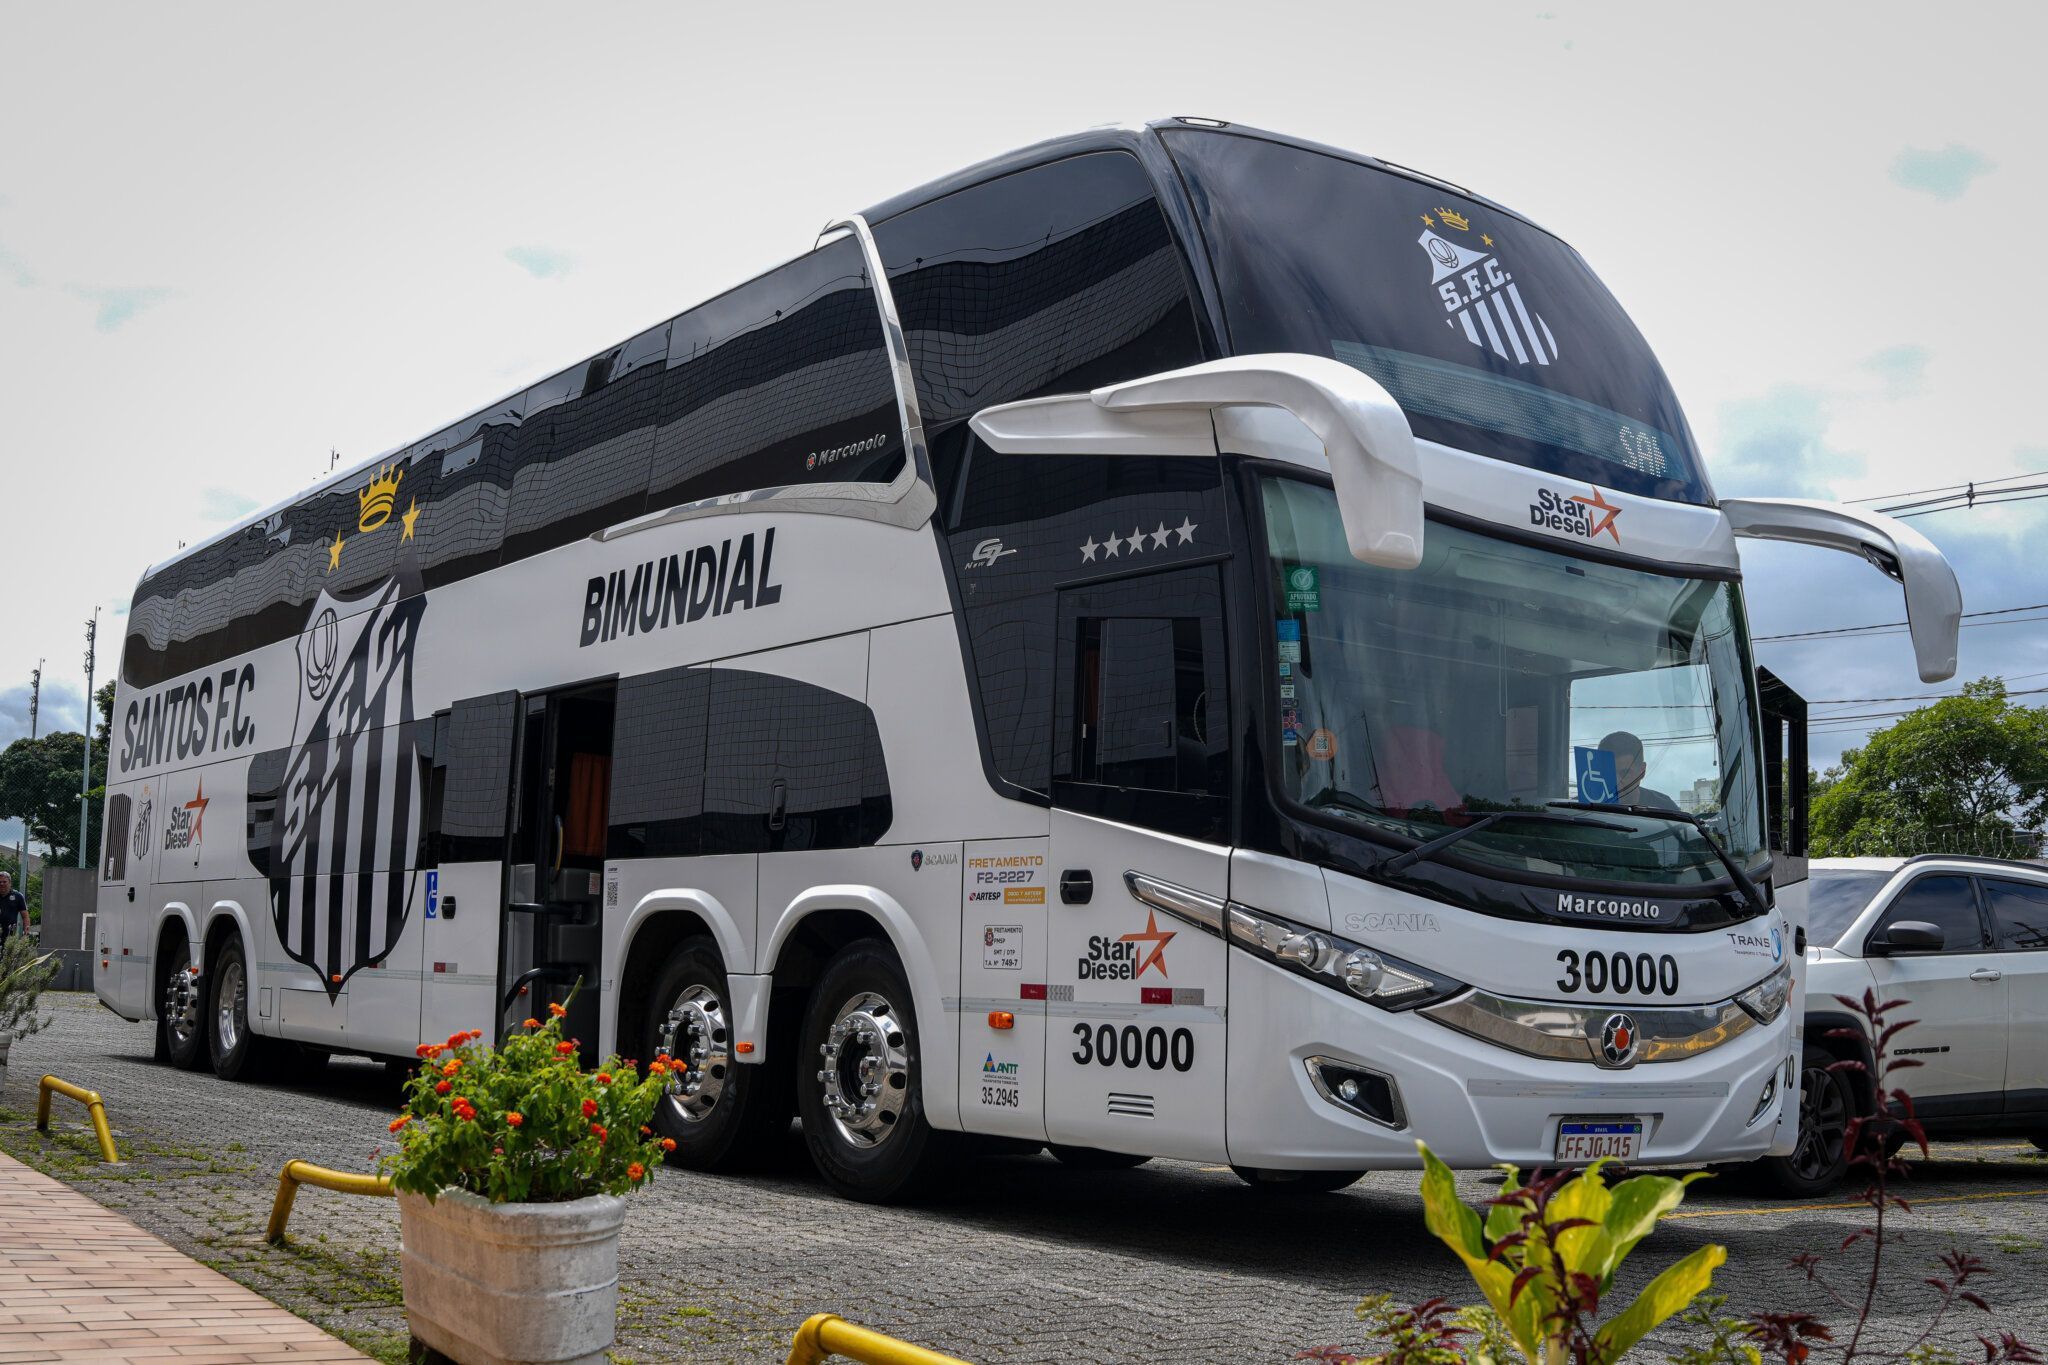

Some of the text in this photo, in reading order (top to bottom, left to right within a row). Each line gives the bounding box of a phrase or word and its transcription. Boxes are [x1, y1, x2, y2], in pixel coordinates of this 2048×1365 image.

[1438, 257, 1512, 313] S.F.C.
[818, 433, 886, 466] Marcopolo
[1538, 488, 1586, 519] Star
[1529, 504, 1591, 538] Diesel
[579, 527, 782, 648] BIMUNDIAL
[120, 662, 255, 773] SANTOS F.C.
[170, 806, 191, 831] Star
[165, 826, 190, 850] Diesel
[924, 853, 958, 866] SCANIA
[969, 856, 1043, 868] FRETAMENTO
[976, 870, 1035, 884] F2-2227
[975, 891, 1001, 901] ARTESP
[1557, 893, 1660, 918] Marcopolo
[1344, 912, 1442, 933] SCANIA
[1088, 935, 1135, 961] Star
[1001, 958, 1018, 967] 749-7
[1078, 957, 1136, 980] Diesel
[1555, 948, 1680, 997] 30000
[1071, 1022, 1195, 1073] 30000
[996, 1062, 1019, 1074] ANTT
[981, 1086, 1019, 1108] 35.2945
